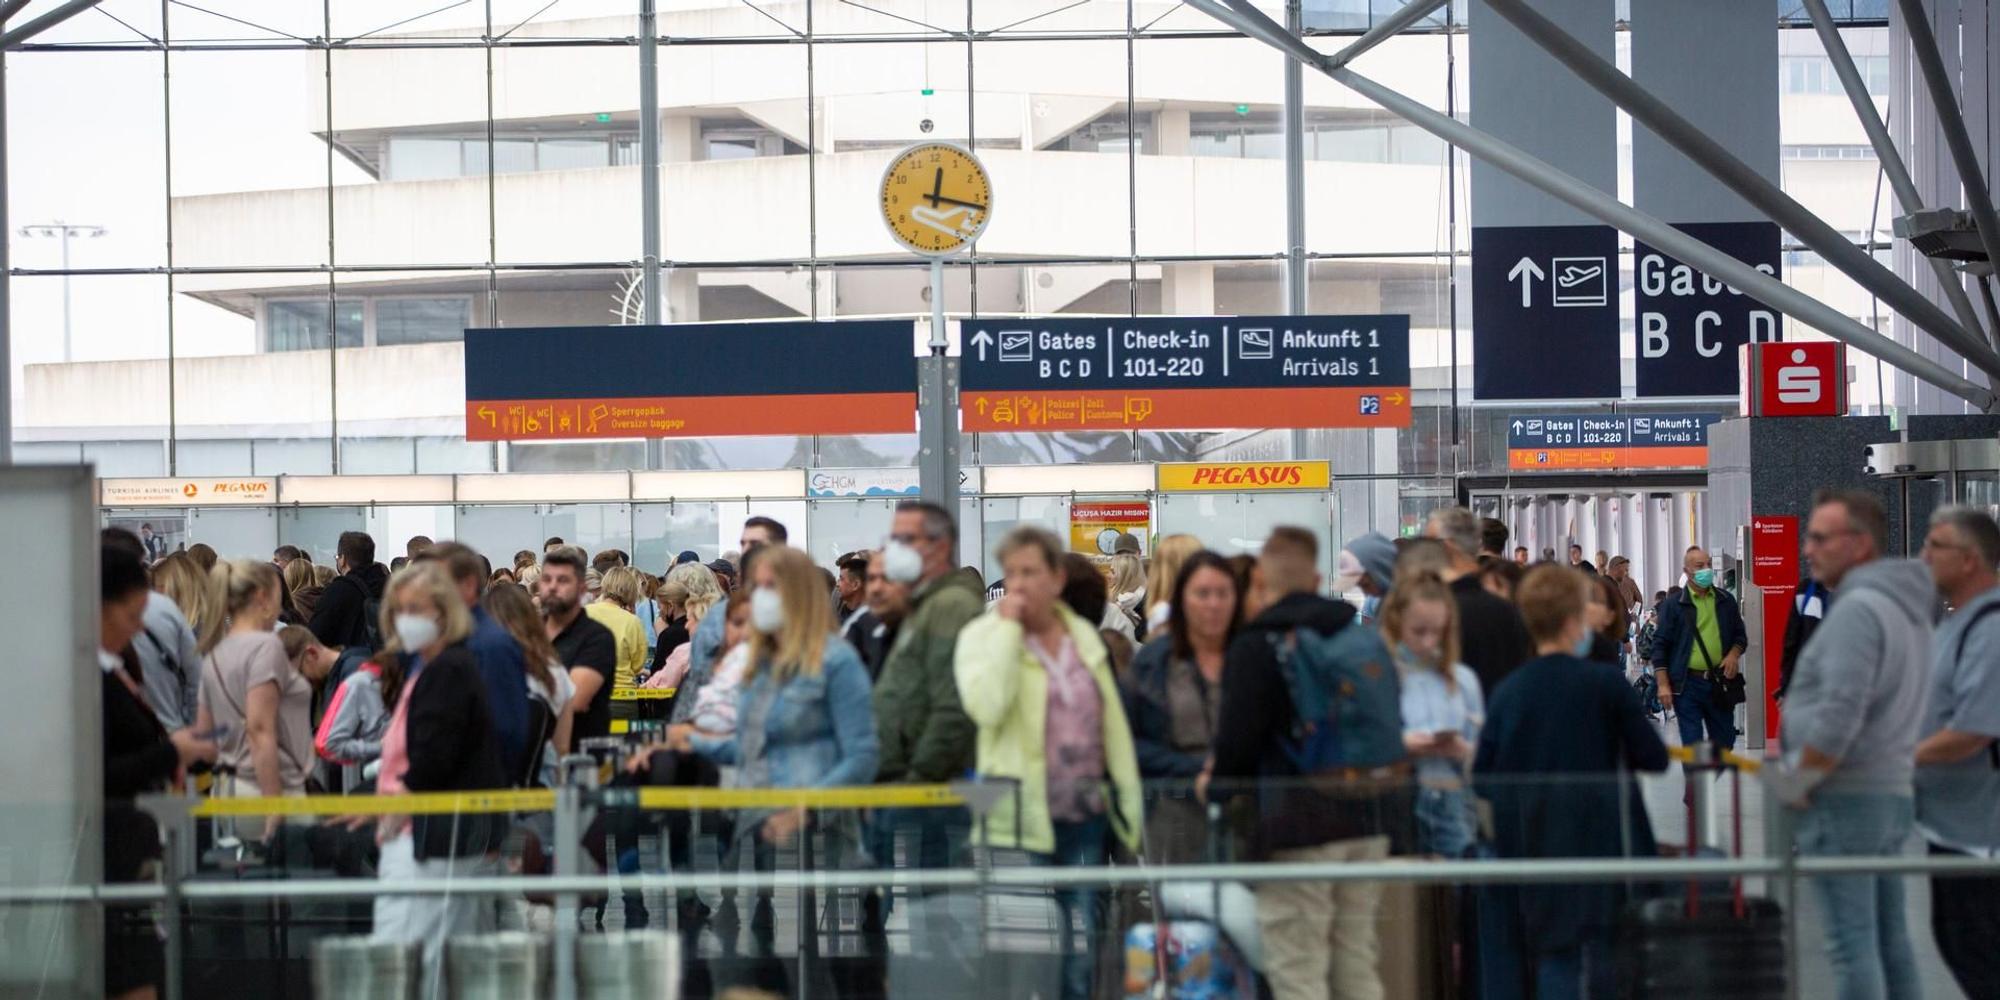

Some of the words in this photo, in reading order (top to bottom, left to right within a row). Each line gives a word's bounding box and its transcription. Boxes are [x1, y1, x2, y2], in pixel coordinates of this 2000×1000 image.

[930, 153, 941, 163] 12
[911, 160, 922, 169] 11
[953, 160, 958, 168] 1
[896, 176, 907, 184] 10
[967, 175, 973, 184] 2
[892, 195, 898, 204] 9
[974, 194, 980, 202] 3
[899, 215, 905, 223] 8
[912, 231, 918, 239] 7
[934, 235, 940, 243] 6
[955, 230, 961, 239] 5
[1282, 329, 1361, 348] Ankunft
[1368, 329, 1380, 348] 1
[1642, 312, 1669, 358] B
[1695, 310, 1722, 357] C
[1039, 331, 1096, 350] Gates
[1123, 330, 1210, 349] Check-in
[1039, 359, 1051, 378] B
[1059, 359, 1071, 378] C
[1079, 359, 1091, 378] D
[1123, 357, 1204, 377] 101-220
[1282, 357, 1359, 376] Arrivals
[1368, 357, 1380, 375] 1
[1361, 396, 1379, 414] P2
[509, 407, 522, 416] WC
[537, 409, 549, 417] WC
[611, 419, 648, 429] Oversize
[650, 418, 685, 430] baggage
[1546, 420, 1574, 430] Gates
[1583, 419, 1625, 430] Check-in
[1654, 418, 1692, 429] Ankunft
[1695, 419, 1701, 429] 1
[1547, 434, 1553, 443] B
[1556, 434, 1562, 443] C
[1566, 434, 1572, 443] D
[1583, 433, 1622, 443] 101-220
[1654, 432, 1691, 442] Arrivals
[1695, 432, 1701, 442] 1
[1192, 466, 1303, 486] PEGASUS
[145, 487, 179, 495] AIRLINES
[213, 482, 268, 492] PEGASUS
[1101, 509, 1123, 517] HAZIR
